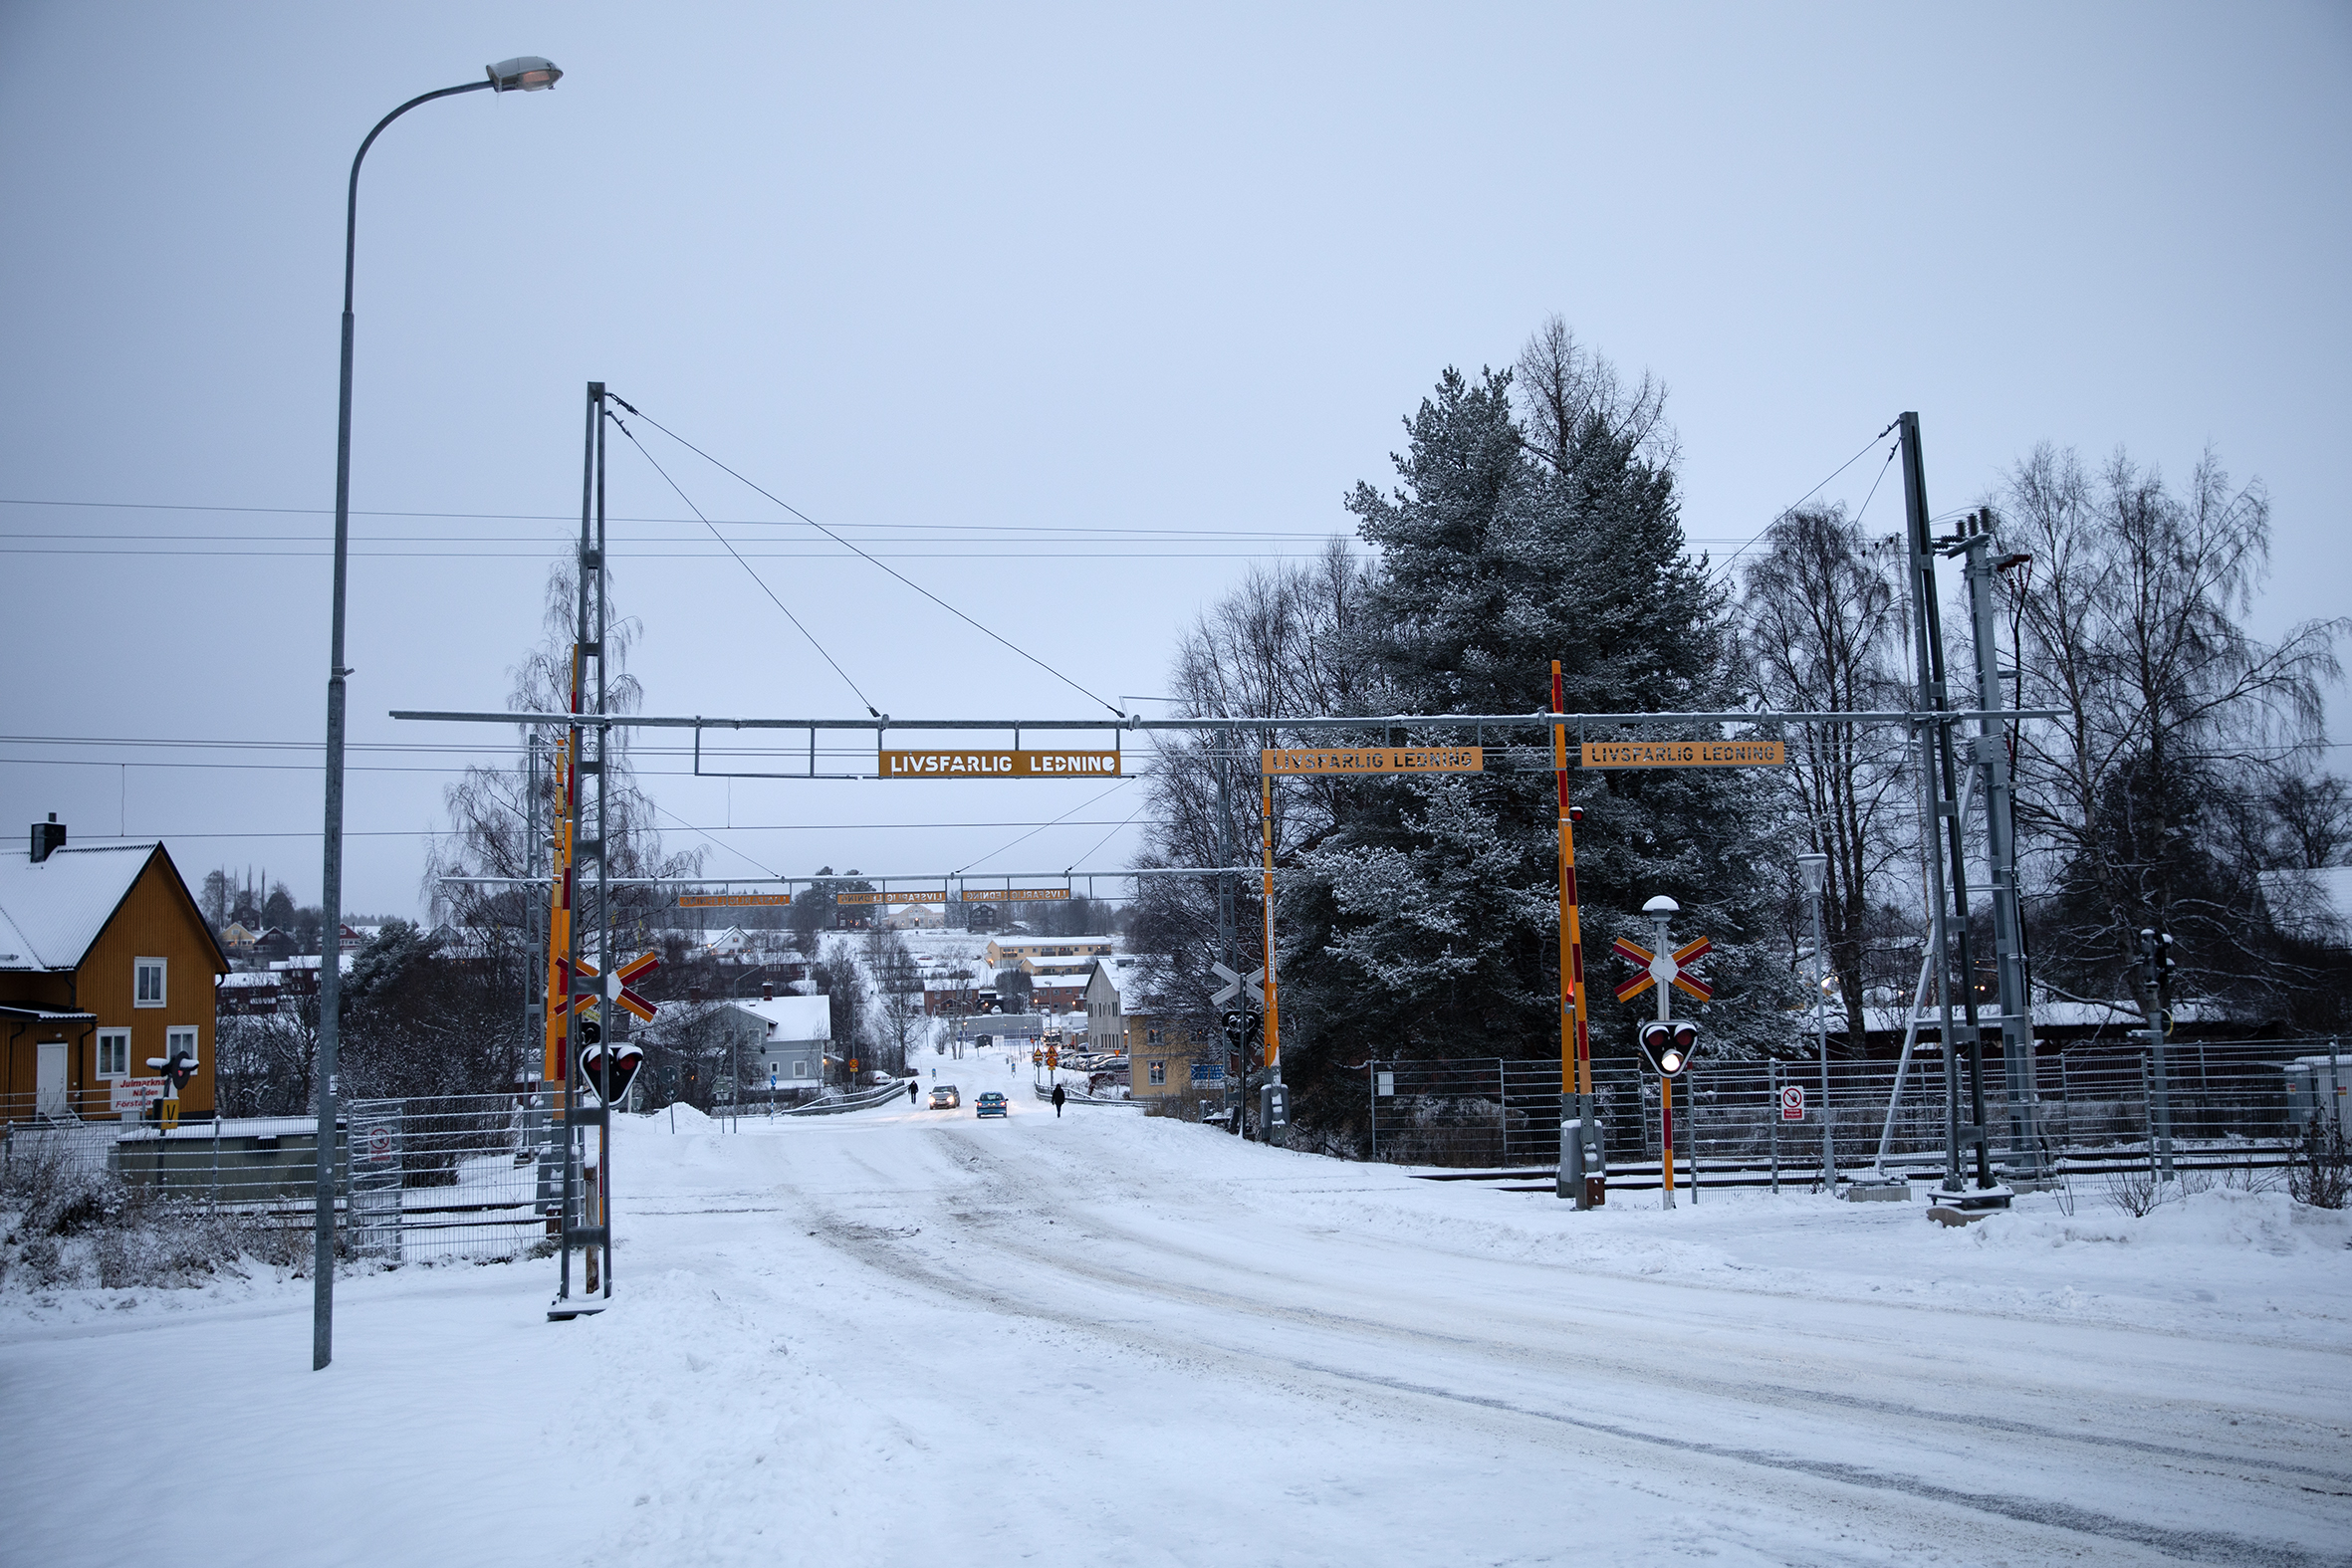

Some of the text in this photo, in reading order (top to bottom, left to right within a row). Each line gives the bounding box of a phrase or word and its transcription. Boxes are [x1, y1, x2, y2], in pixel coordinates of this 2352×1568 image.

[1273, 752, 1472, 770] LIVSFARLIG LEDNING
[1591, 746, 1775, 763] LIVSFARLIG LEDNING
[890, 756, 1115, 773] LIVSFARLIG LEDNING
[119, 1078, 169, 1088] Julmarkna
[166, 1104, 176, 1125] V
